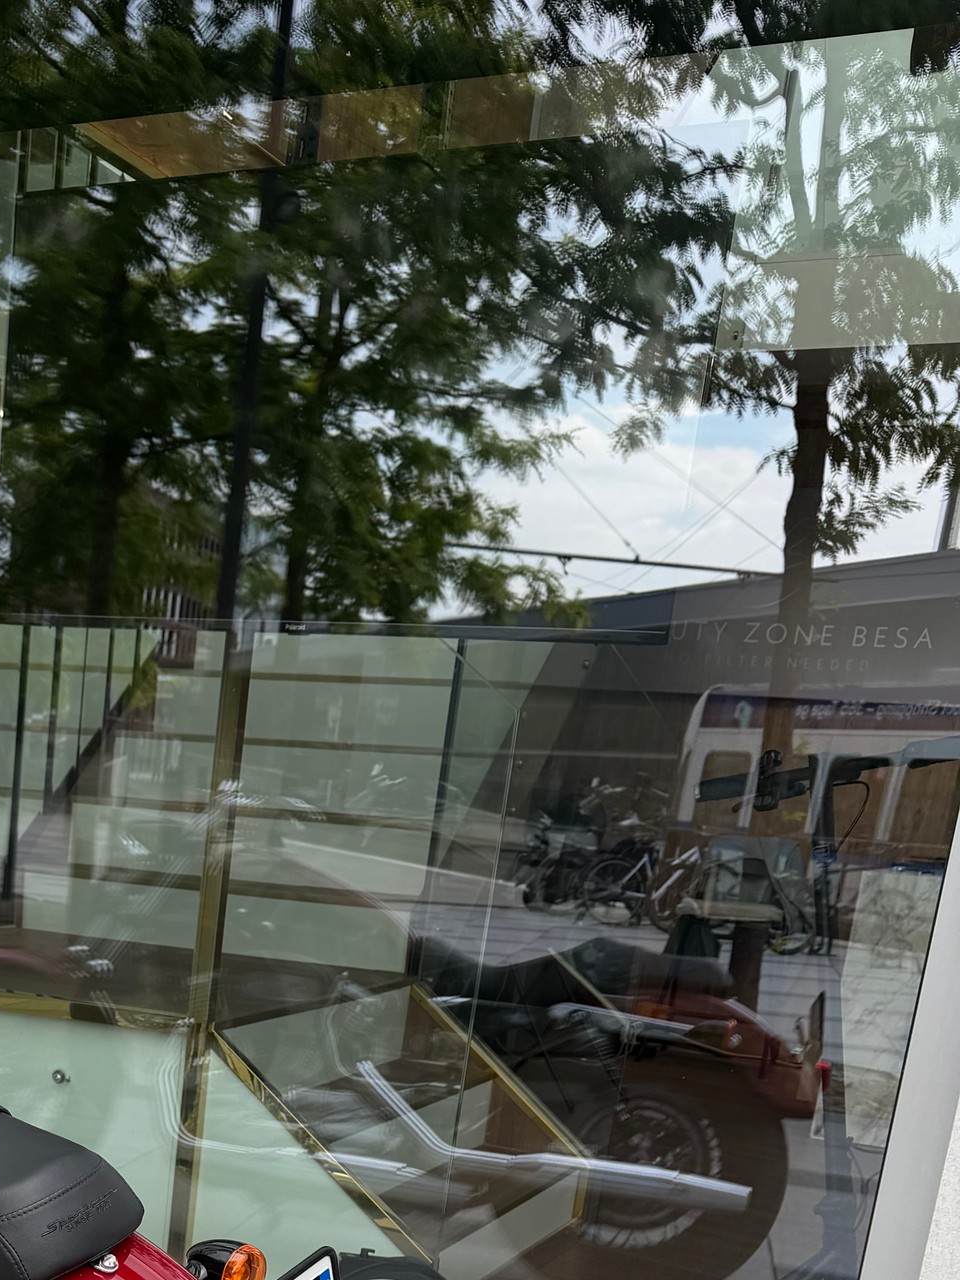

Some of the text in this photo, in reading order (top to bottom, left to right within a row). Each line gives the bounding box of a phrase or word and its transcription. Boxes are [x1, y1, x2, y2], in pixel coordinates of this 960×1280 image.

[743, 622, 835, 647] ZONE
[851, 626, 933, 650] BESA
[704, 655, 772, 669] FILTER
[786, 657, 870, 672] NEEDED
